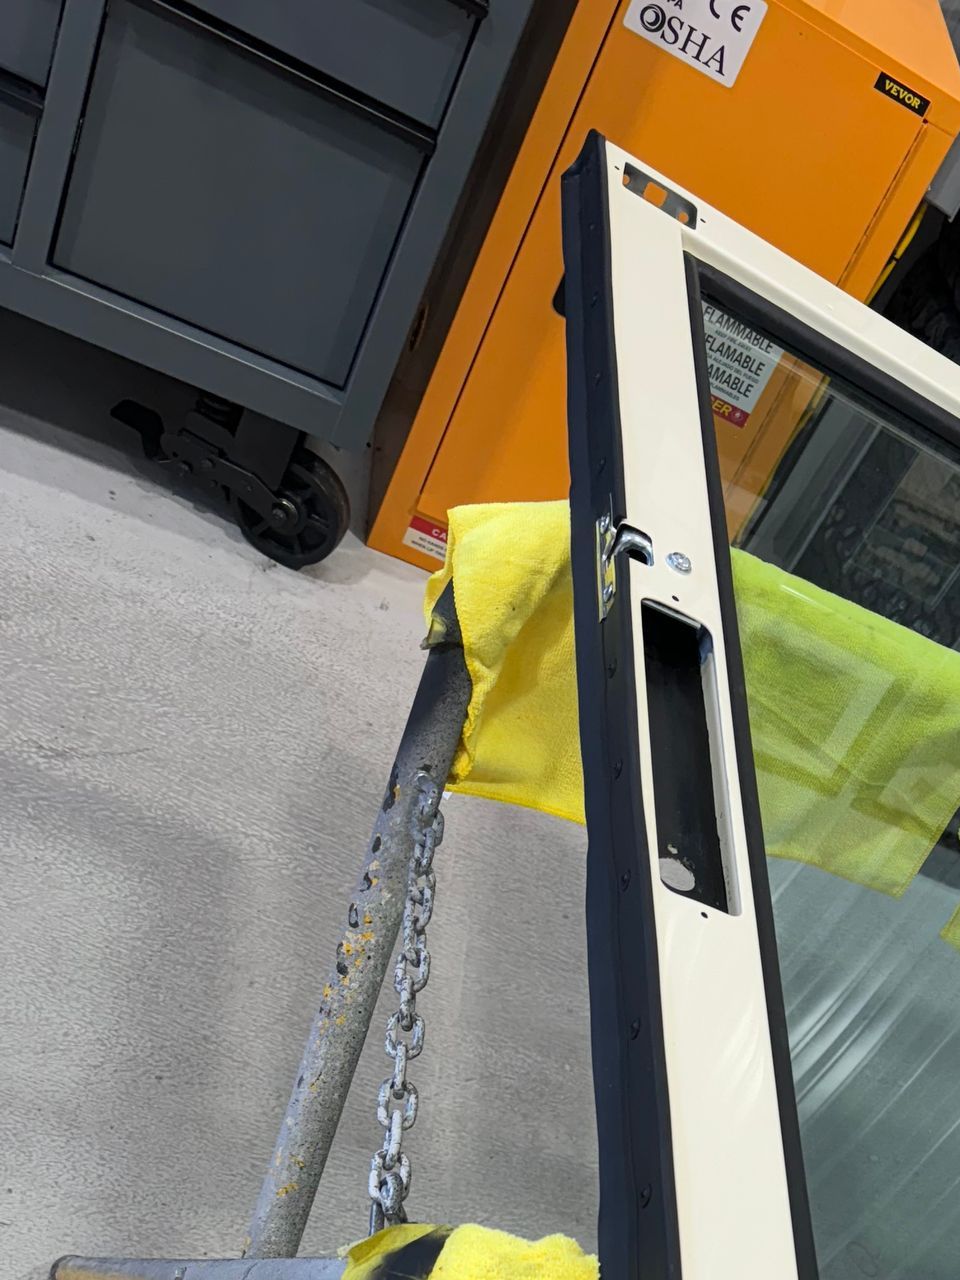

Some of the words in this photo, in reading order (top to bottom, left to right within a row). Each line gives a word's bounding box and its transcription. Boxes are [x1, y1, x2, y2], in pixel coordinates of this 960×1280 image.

[639, 3, 726, 77] OSHA
[885, 79, 921, 109] VEVOR
[703, 305, 774, 354] FLAMMABLE
[704, 333, 766, 377] FLAMABLE
[707, 363, 754, 398] AMABLE
[712, 399, 733, 417] ER
